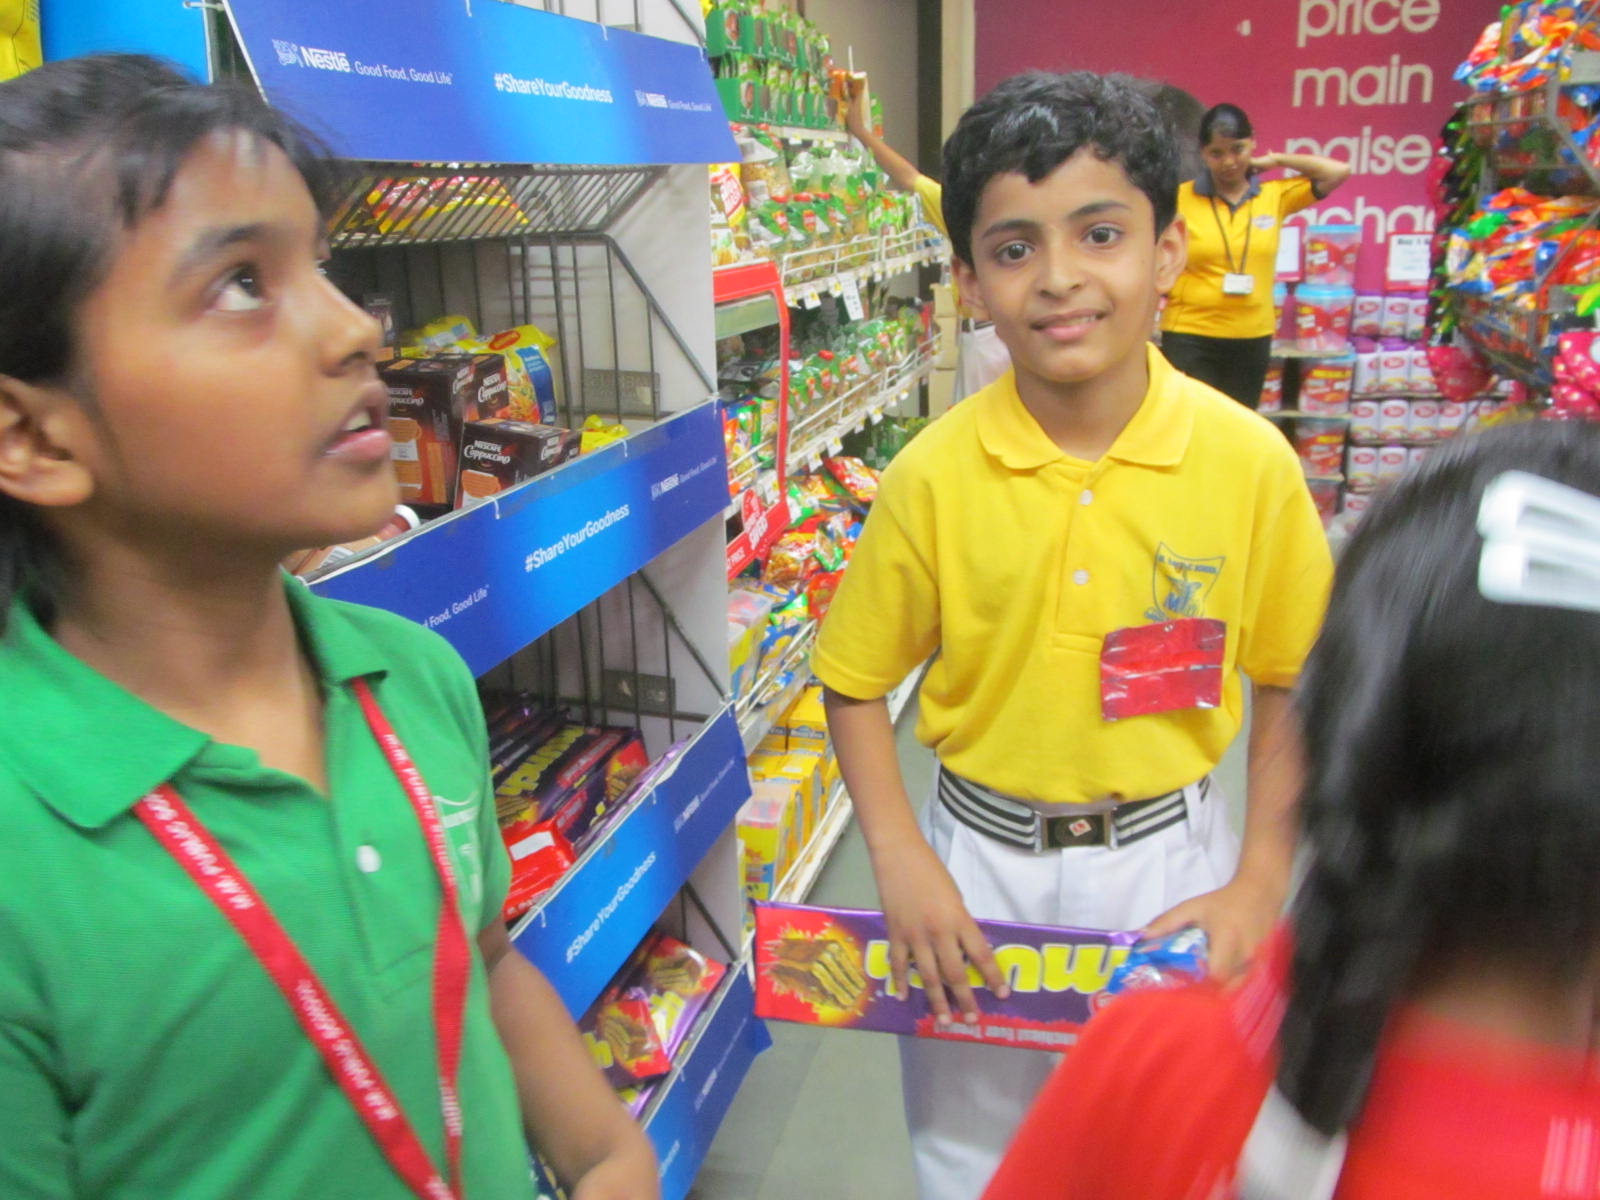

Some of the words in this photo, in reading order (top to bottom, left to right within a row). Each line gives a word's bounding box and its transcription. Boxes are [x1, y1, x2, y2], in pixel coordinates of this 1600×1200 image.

[1297, 0, 1441, 47] price
[354, 61, 382, 78] Good
[409, 68, 435, 84] Good
[494, 73, 614, 104] #ShareYourGoodness
[1293, 54, 1434, 107] main
[524, 504, 630, 573] #ShareYourGoodness
[452, 594, 473, 614] Good
